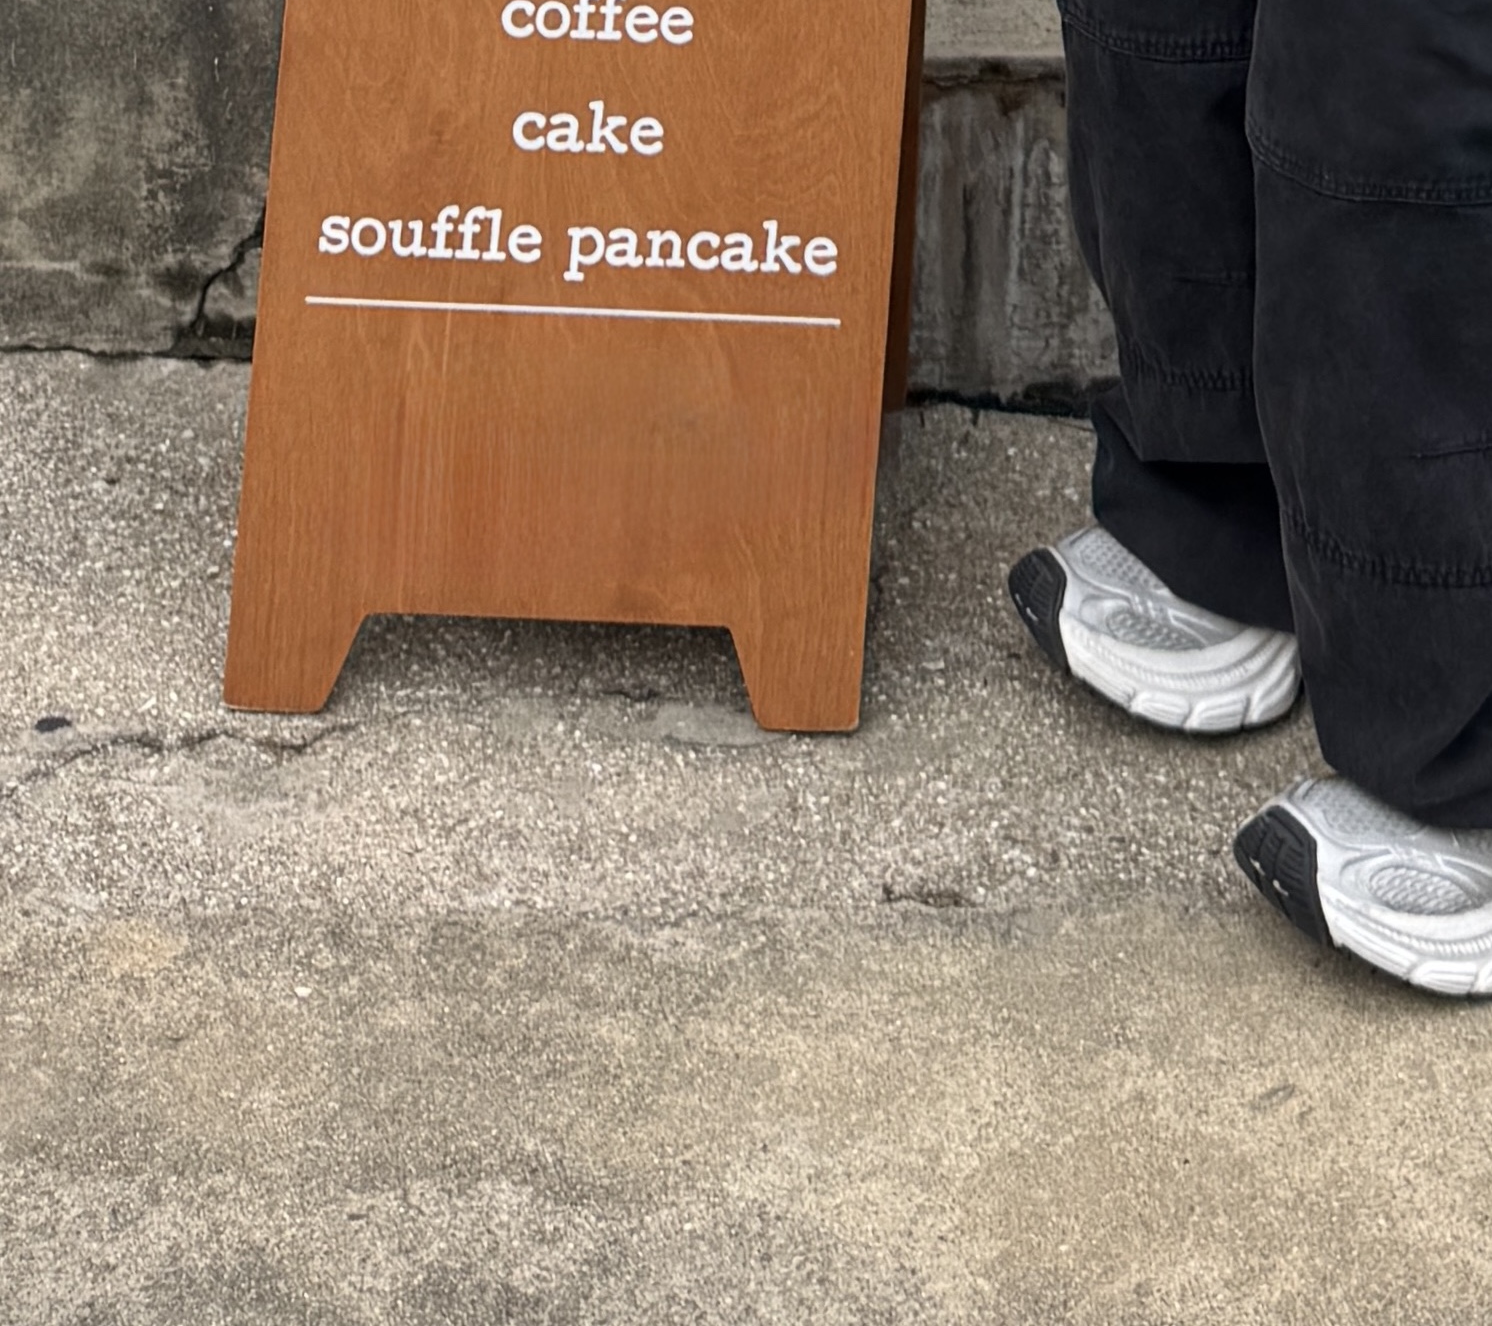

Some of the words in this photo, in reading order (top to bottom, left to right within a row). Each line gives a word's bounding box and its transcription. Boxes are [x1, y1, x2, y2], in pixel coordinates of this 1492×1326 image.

[511, 99, 665, 157] cake
[317, 203, 544, 265] souffle
[562, 218, 839, 283] pancake
